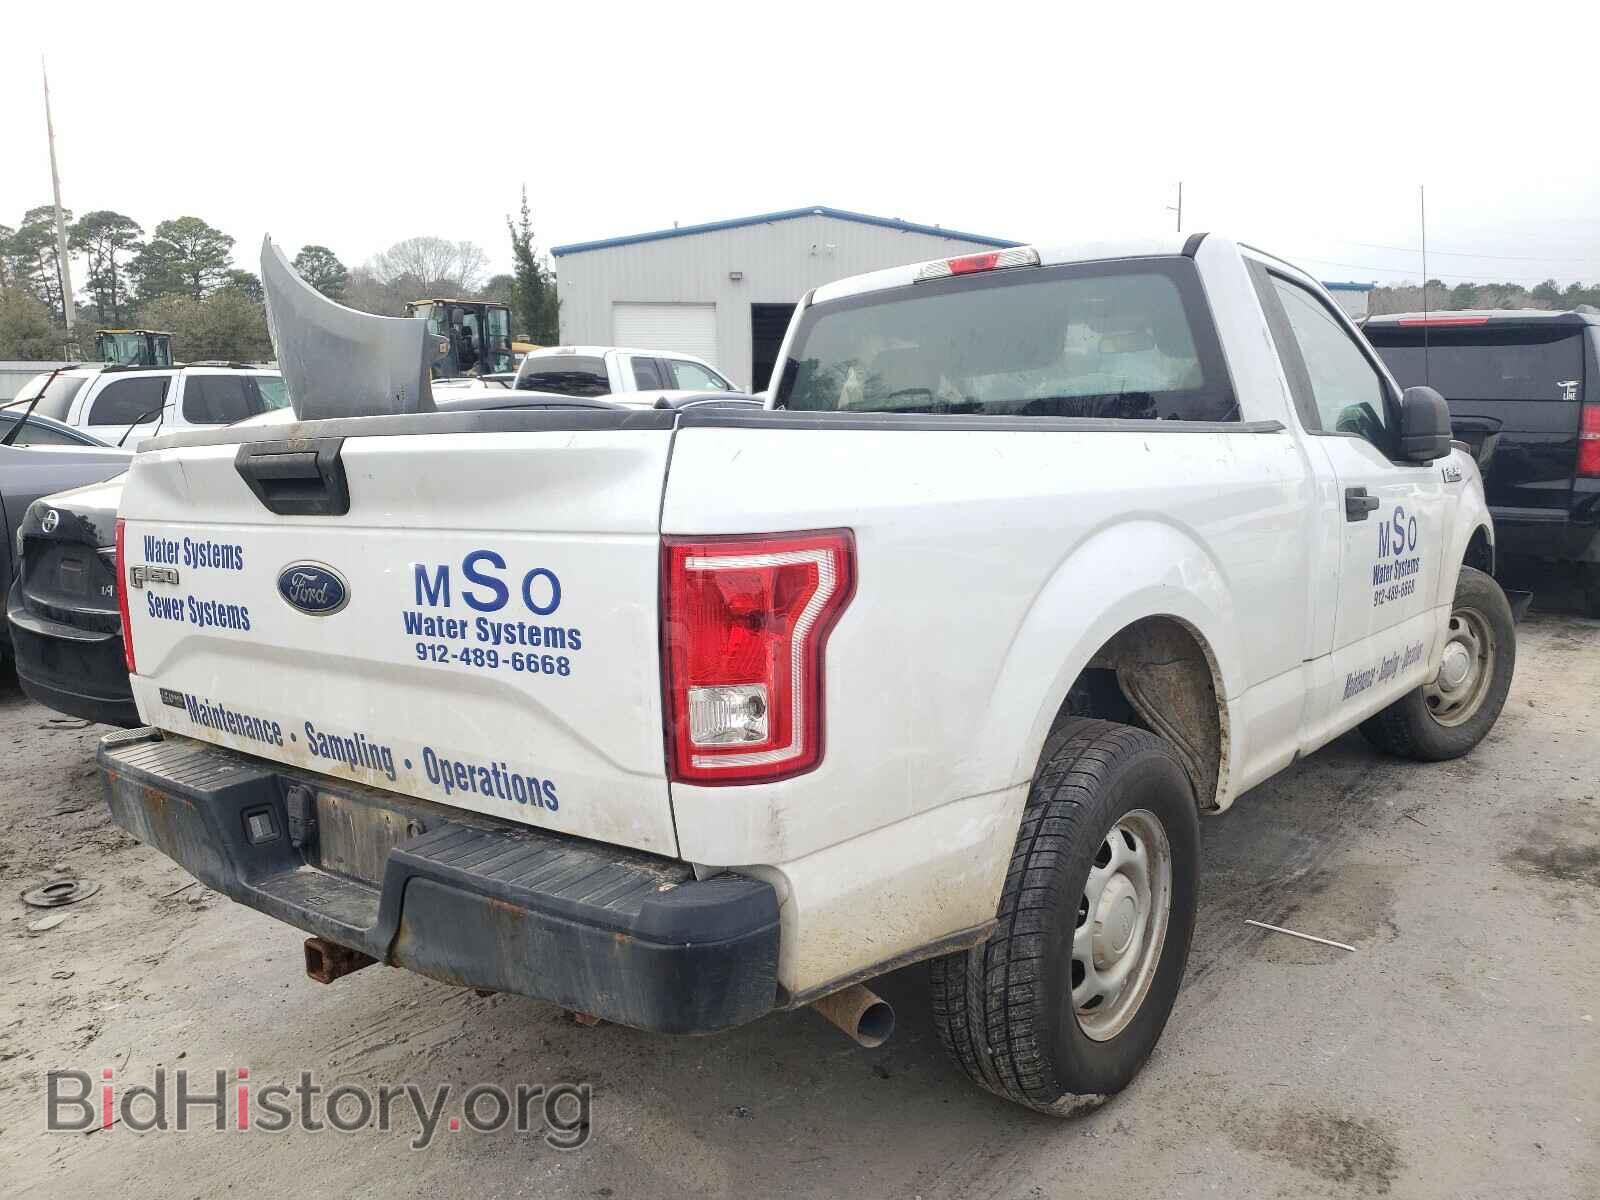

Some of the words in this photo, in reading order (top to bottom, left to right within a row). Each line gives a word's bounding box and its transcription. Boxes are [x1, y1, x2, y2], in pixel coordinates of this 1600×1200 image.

[1378, 505, 1417, 558] MSO
[144, 535, 180, 564] Water
[184, 537, 243, 570] Systems
[1373, 563, 1393, 586] Water
[1394, 557, 1420, 580] Systems
[289, 572, 329, 604] Ford
[414, 549, 562, 615] MSO
[147, 591, 185, 621] Sewer
[188, 595, 251, 631] Systems
[403, 611, 468, 639] Water
[475, 616, 583, 650] Systems
[415, 642, 572, 676] 912-489-6668
[185, 693, 284, 747] Maintenance
[305, 721, 397, 782] Sampling
[422, 746, 560, 812] Operations
